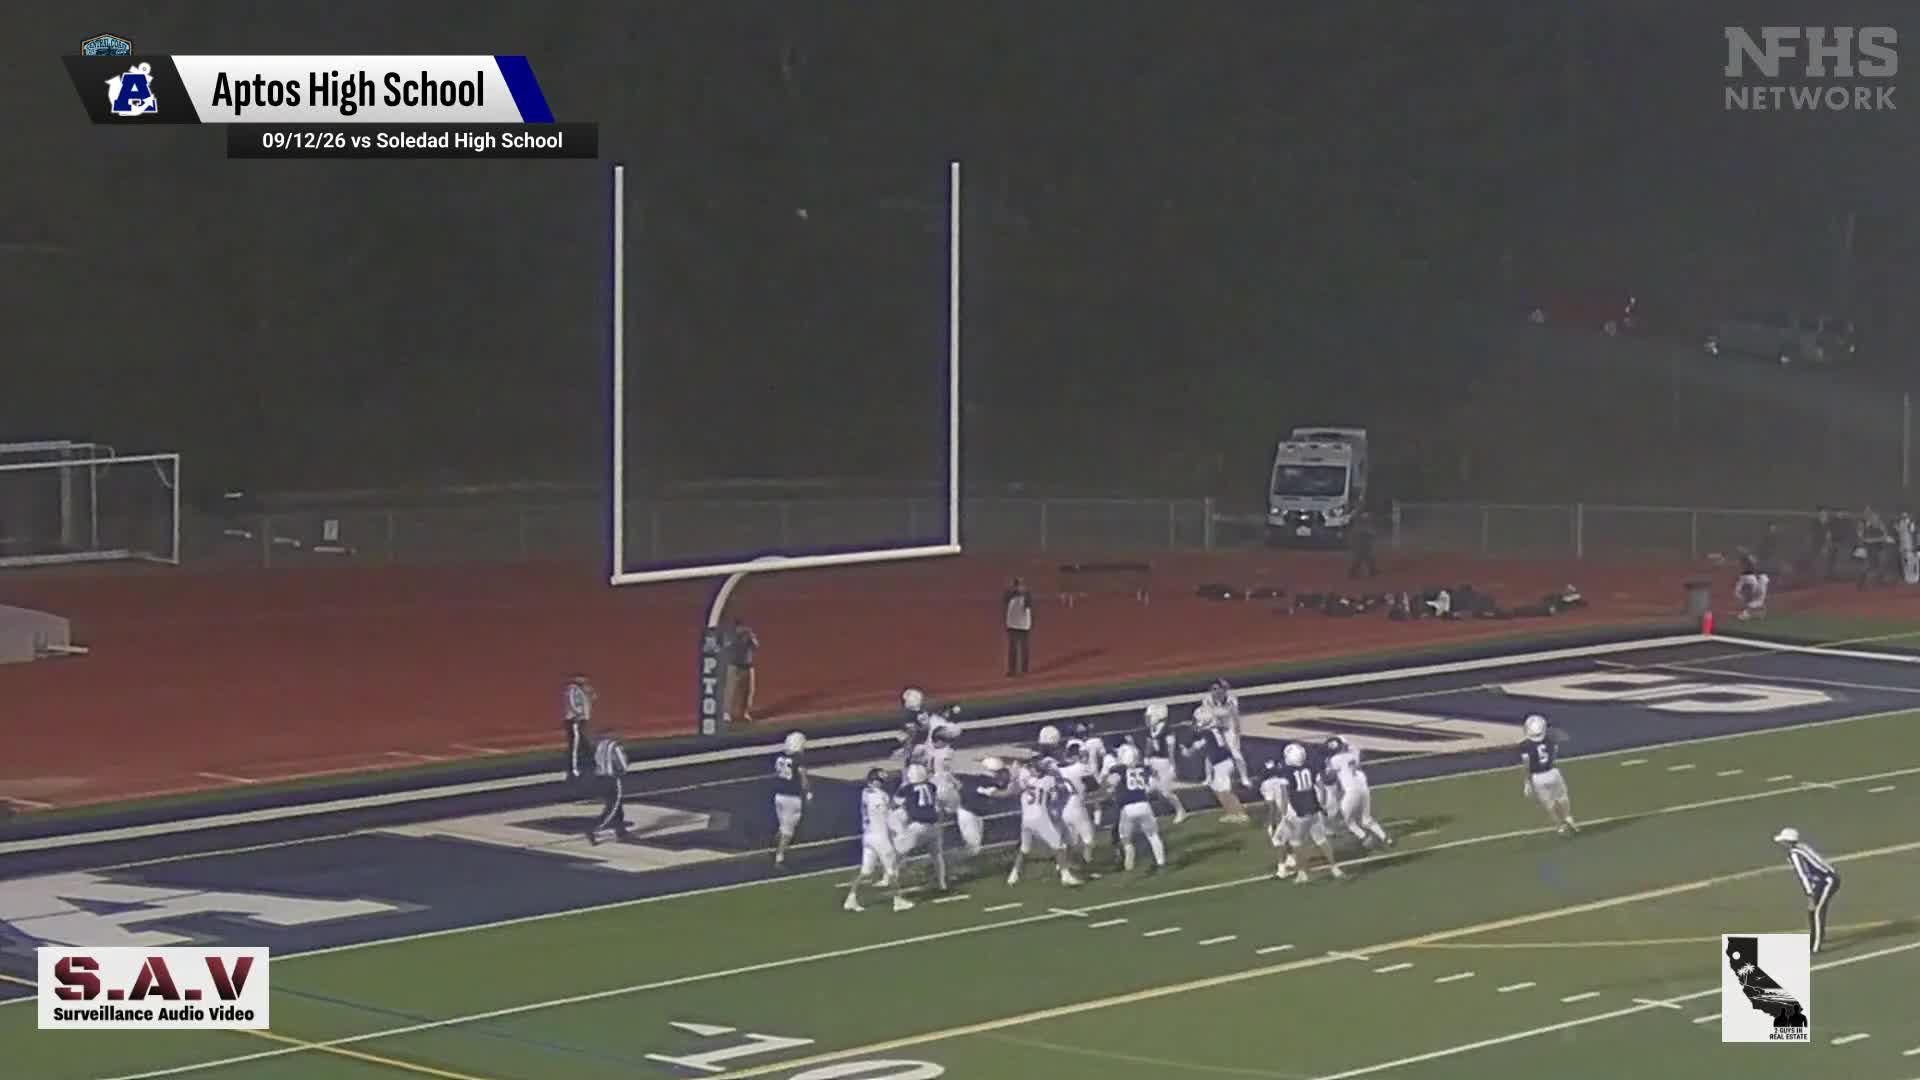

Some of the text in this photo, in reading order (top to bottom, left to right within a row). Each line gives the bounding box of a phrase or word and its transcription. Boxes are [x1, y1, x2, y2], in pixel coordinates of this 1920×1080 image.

[1126, 768, 1145, 790] 65
[1293, 768, 1312, 791] 10
[914, 784, 933, 806] 71
